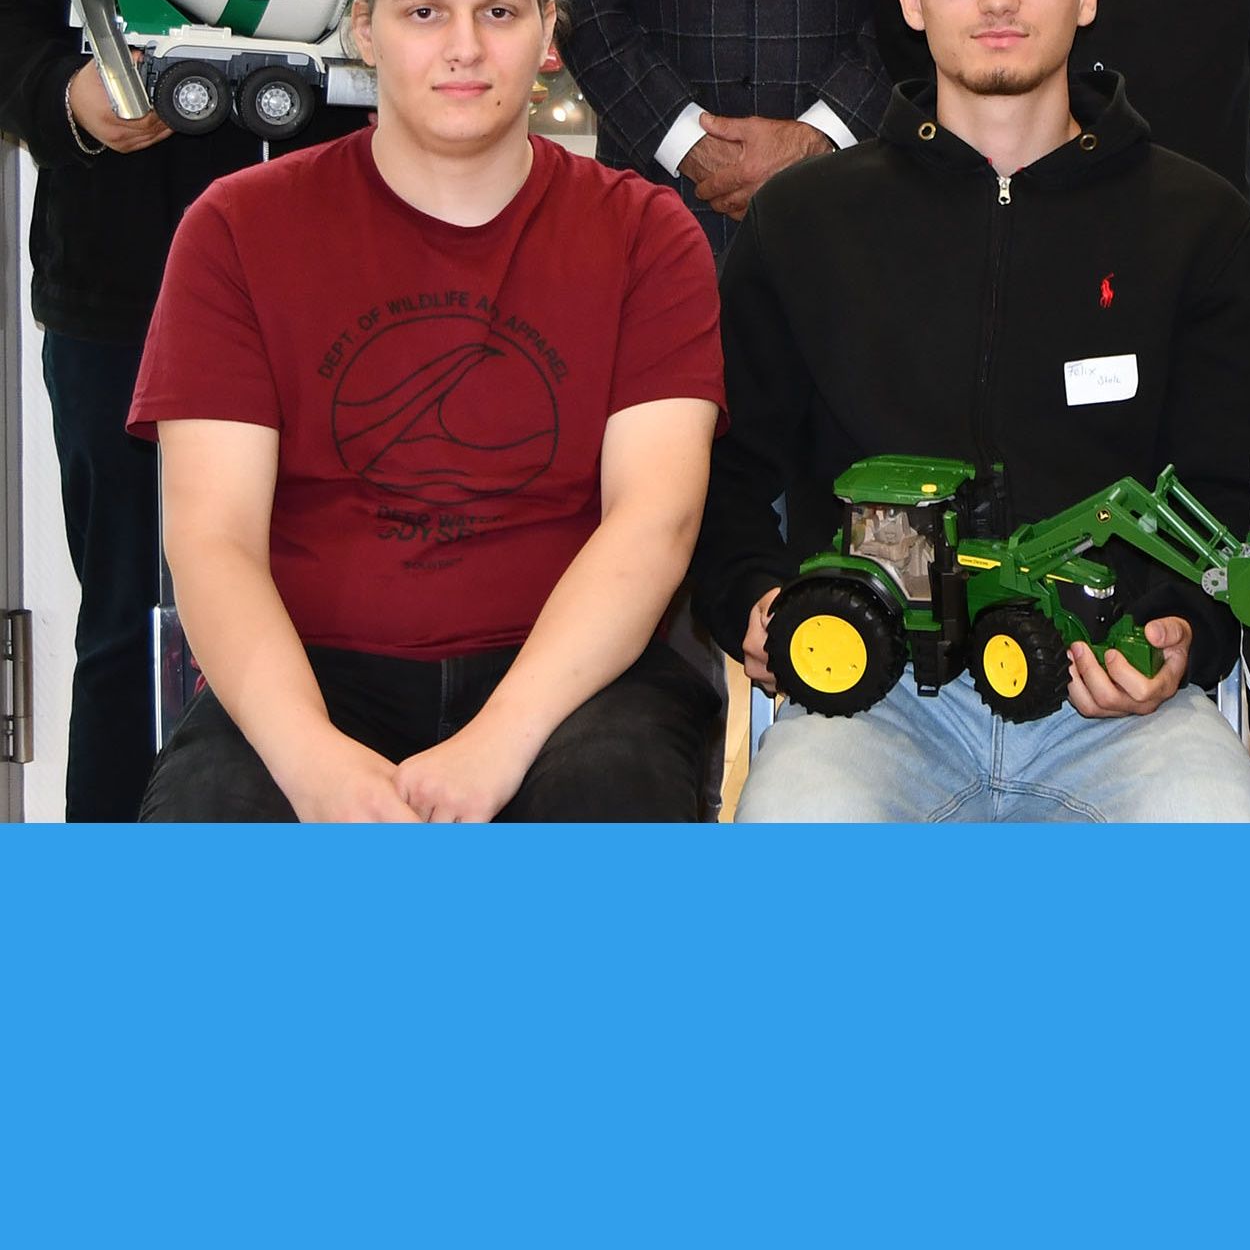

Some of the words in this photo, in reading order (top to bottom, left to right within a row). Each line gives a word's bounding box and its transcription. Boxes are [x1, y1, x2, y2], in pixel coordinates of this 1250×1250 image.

[357, 306, 381, 331] OF
[387, 291, 470, 315] WILDLIFE
[504, 315, 570, 384] APPAREL
